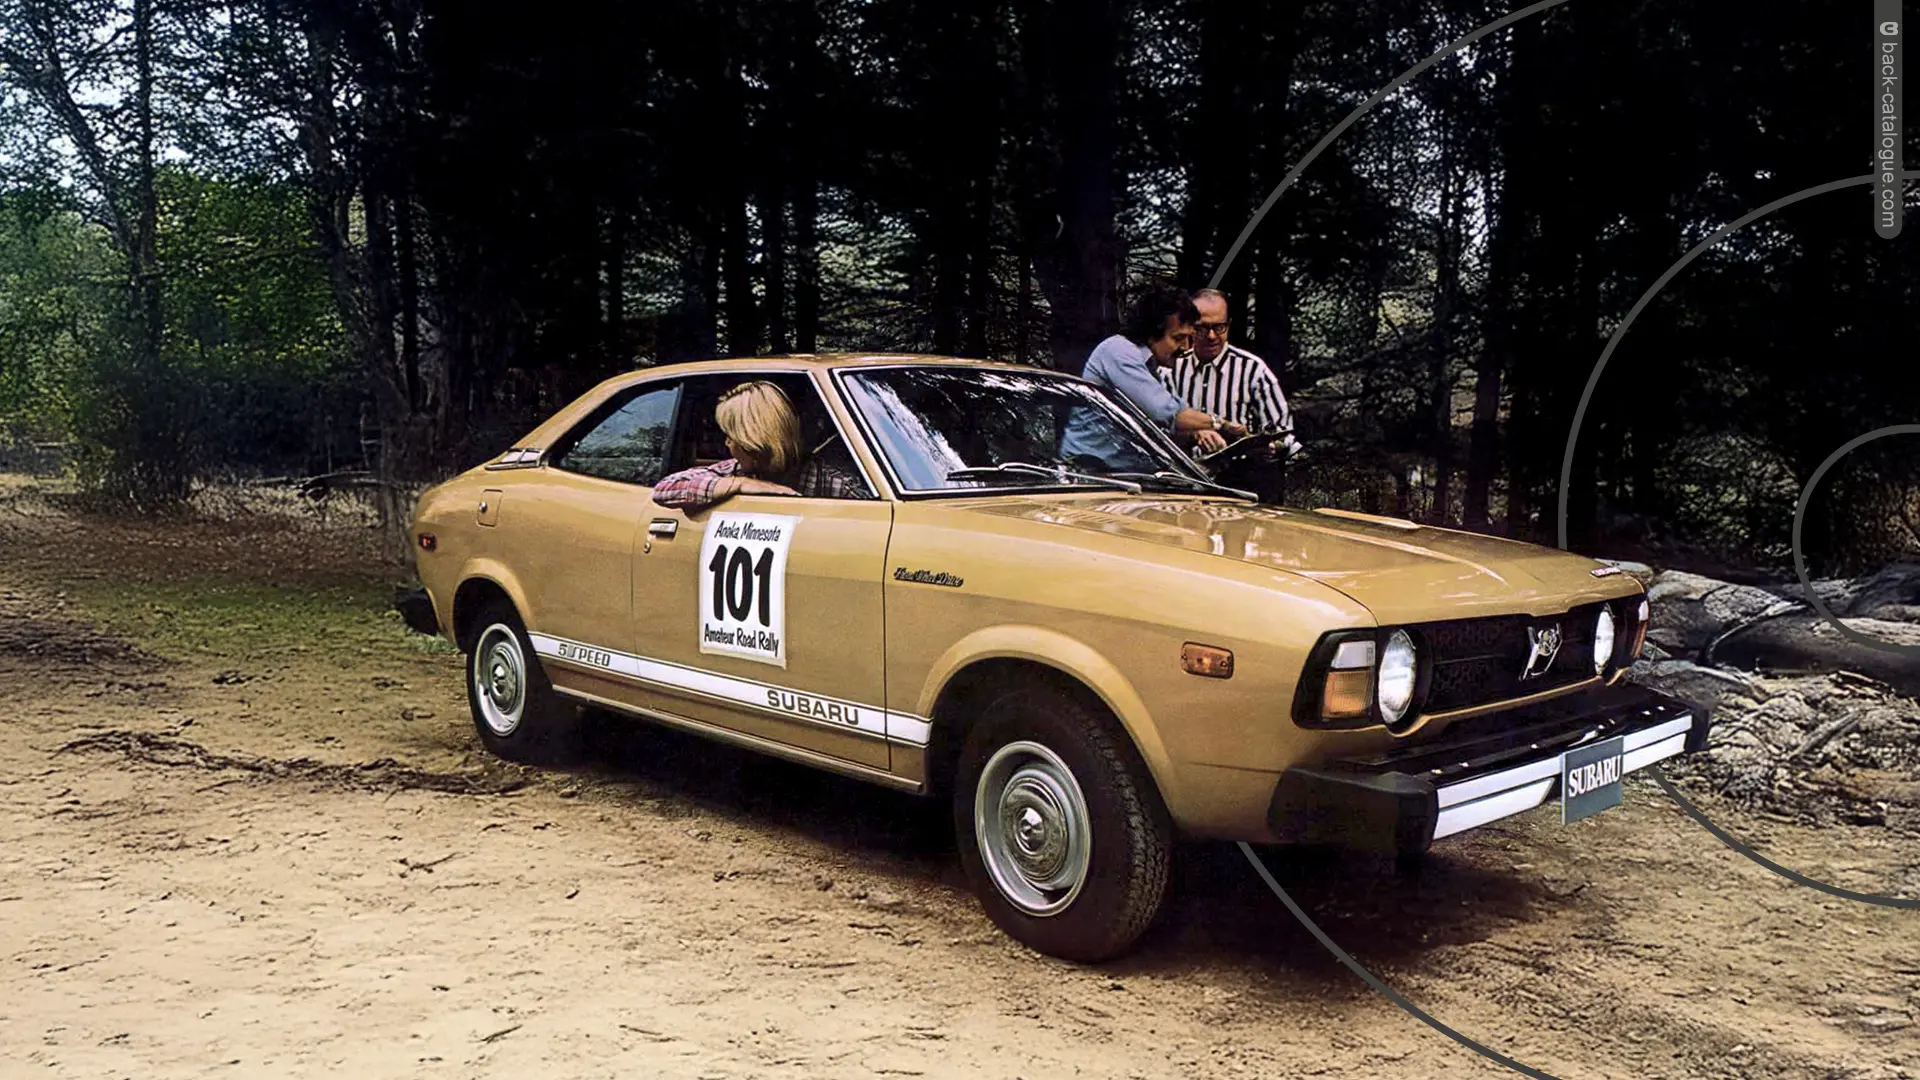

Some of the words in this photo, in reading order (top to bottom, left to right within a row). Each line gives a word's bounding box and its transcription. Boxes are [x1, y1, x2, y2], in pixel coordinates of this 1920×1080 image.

[714, 520, 739, 540] Anoka
[740, 521, 781, 542] Minnesota
[709, 544, 774, 627] 101
[704, 623, 734, 645] Amateur
[736, 628, 756, 649] Road
[758, 631, 780, 657] Rally
[767, 689, 859, 725] SUBARU
[1568, 754, 1621, 798] SUBARU
